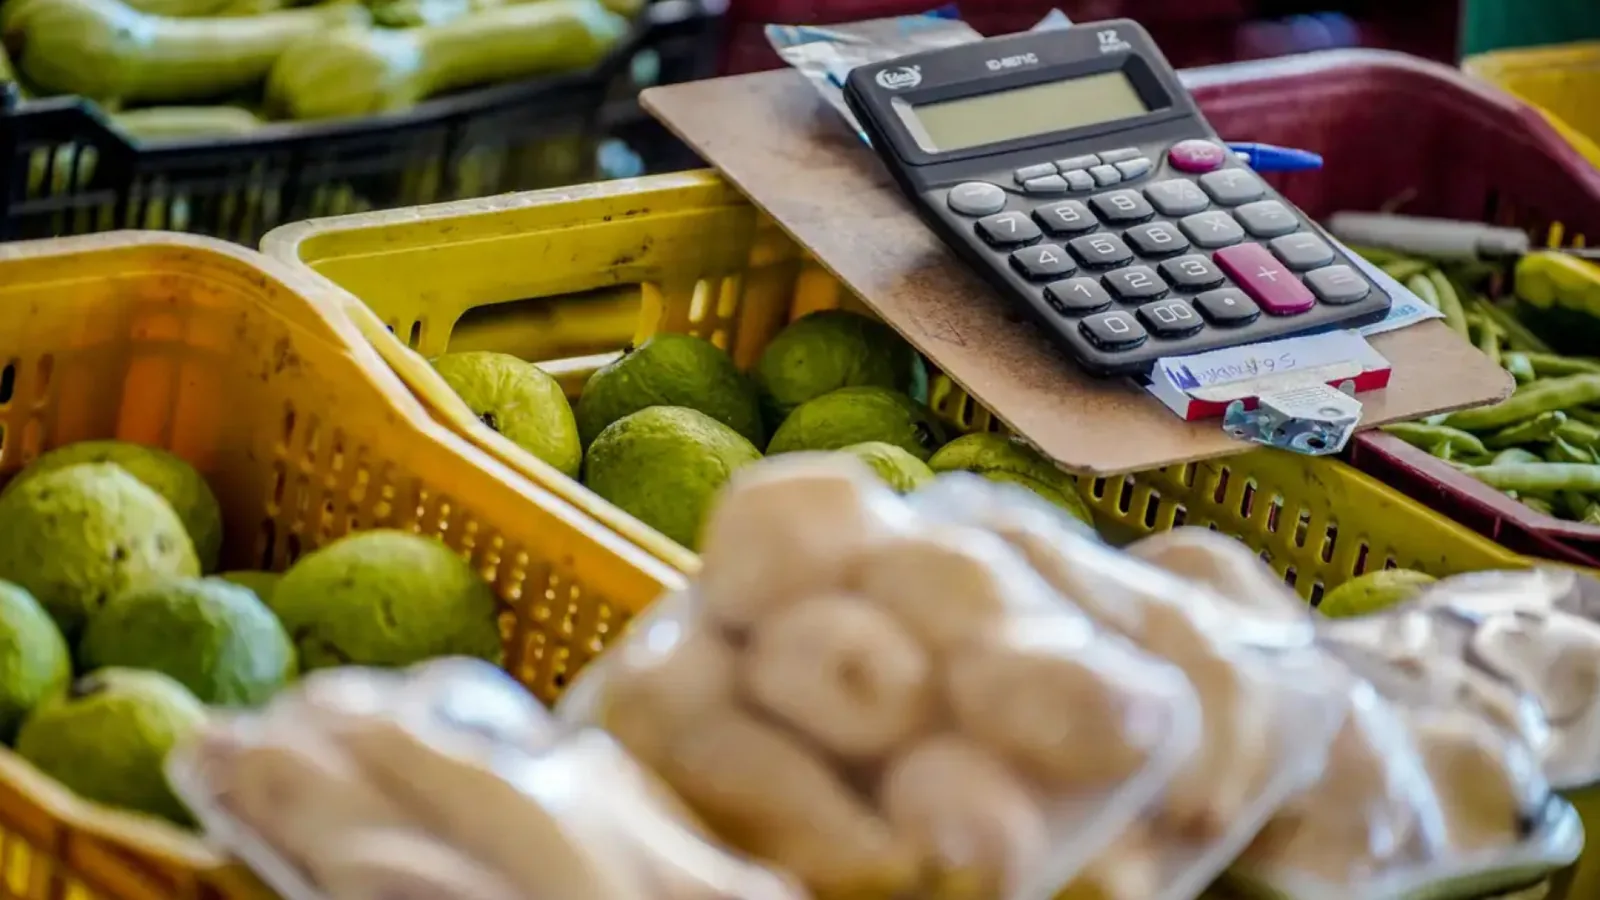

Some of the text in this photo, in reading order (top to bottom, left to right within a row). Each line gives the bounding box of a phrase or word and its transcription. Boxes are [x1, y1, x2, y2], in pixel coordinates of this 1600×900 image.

[996, 217, 1016, 233] 7
[1054, 206, 1081, 222] 8
[1110, 195, 1136, 211] 9
[1039, 250, 1059, 264] 4
[1089, 238, 1115, 254] 5
[1145, 227, 1173, 243] 6
[1073, 283, 1092, 298] 1
[1123, 272, 1153, 288] 2
[1179, 259, 1208, 276] 3
[1103, 303, 1192, 333] 0 00
